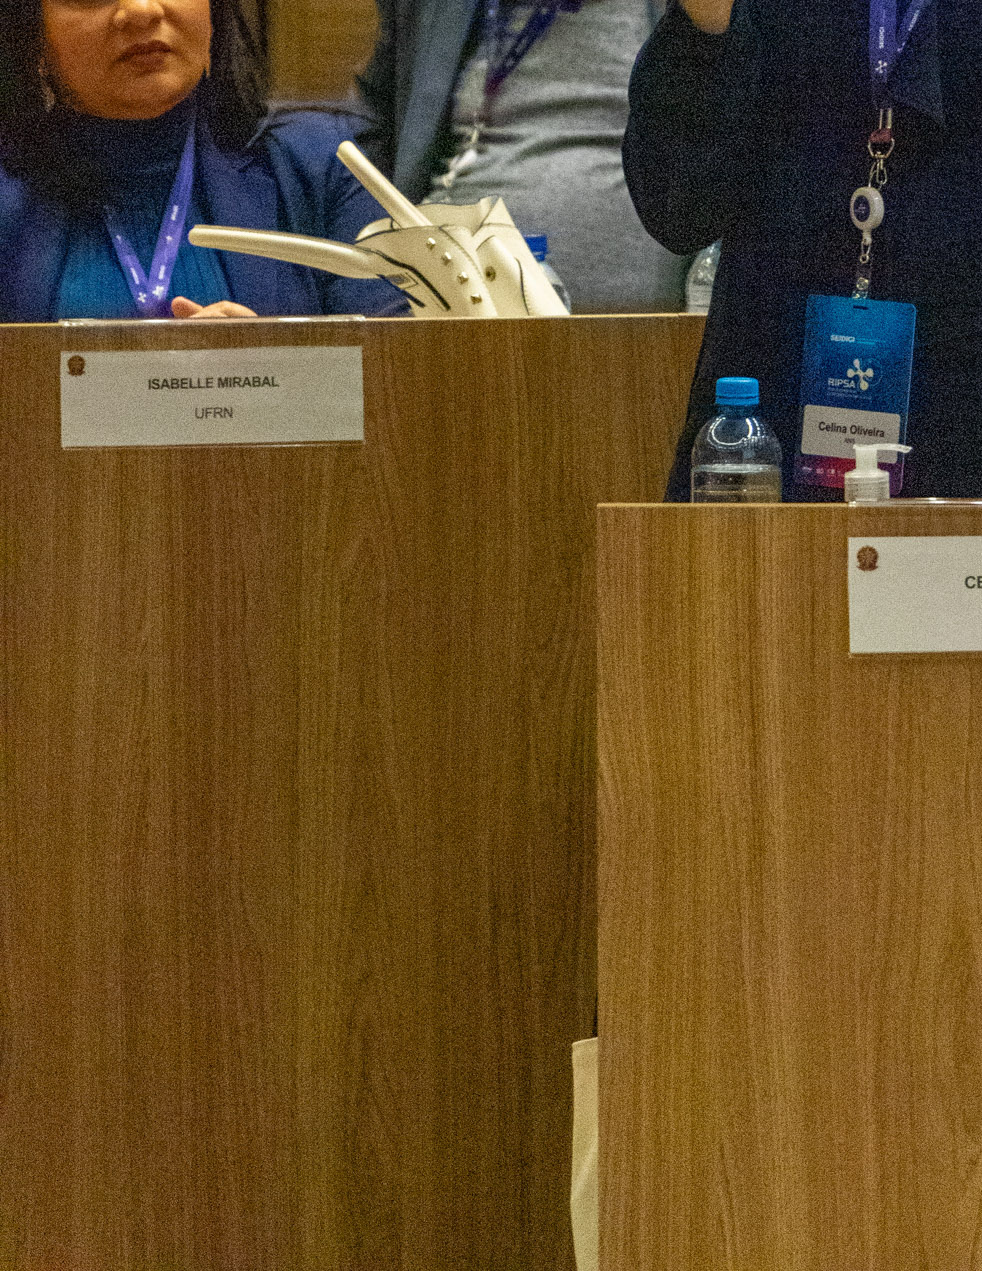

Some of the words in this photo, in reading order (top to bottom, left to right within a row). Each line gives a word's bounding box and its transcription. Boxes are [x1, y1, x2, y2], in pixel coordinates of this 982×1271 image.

[148, 377, 214, 390] ISABELLE
[218, 376, 279, 388] MIRABAL
[827, 378, 856, 389] RIPSA
[195, 407, 234, 420] UFRN
[818, 422, 847, 433] Celina
[850, 425, 885, 437] Oliveira
